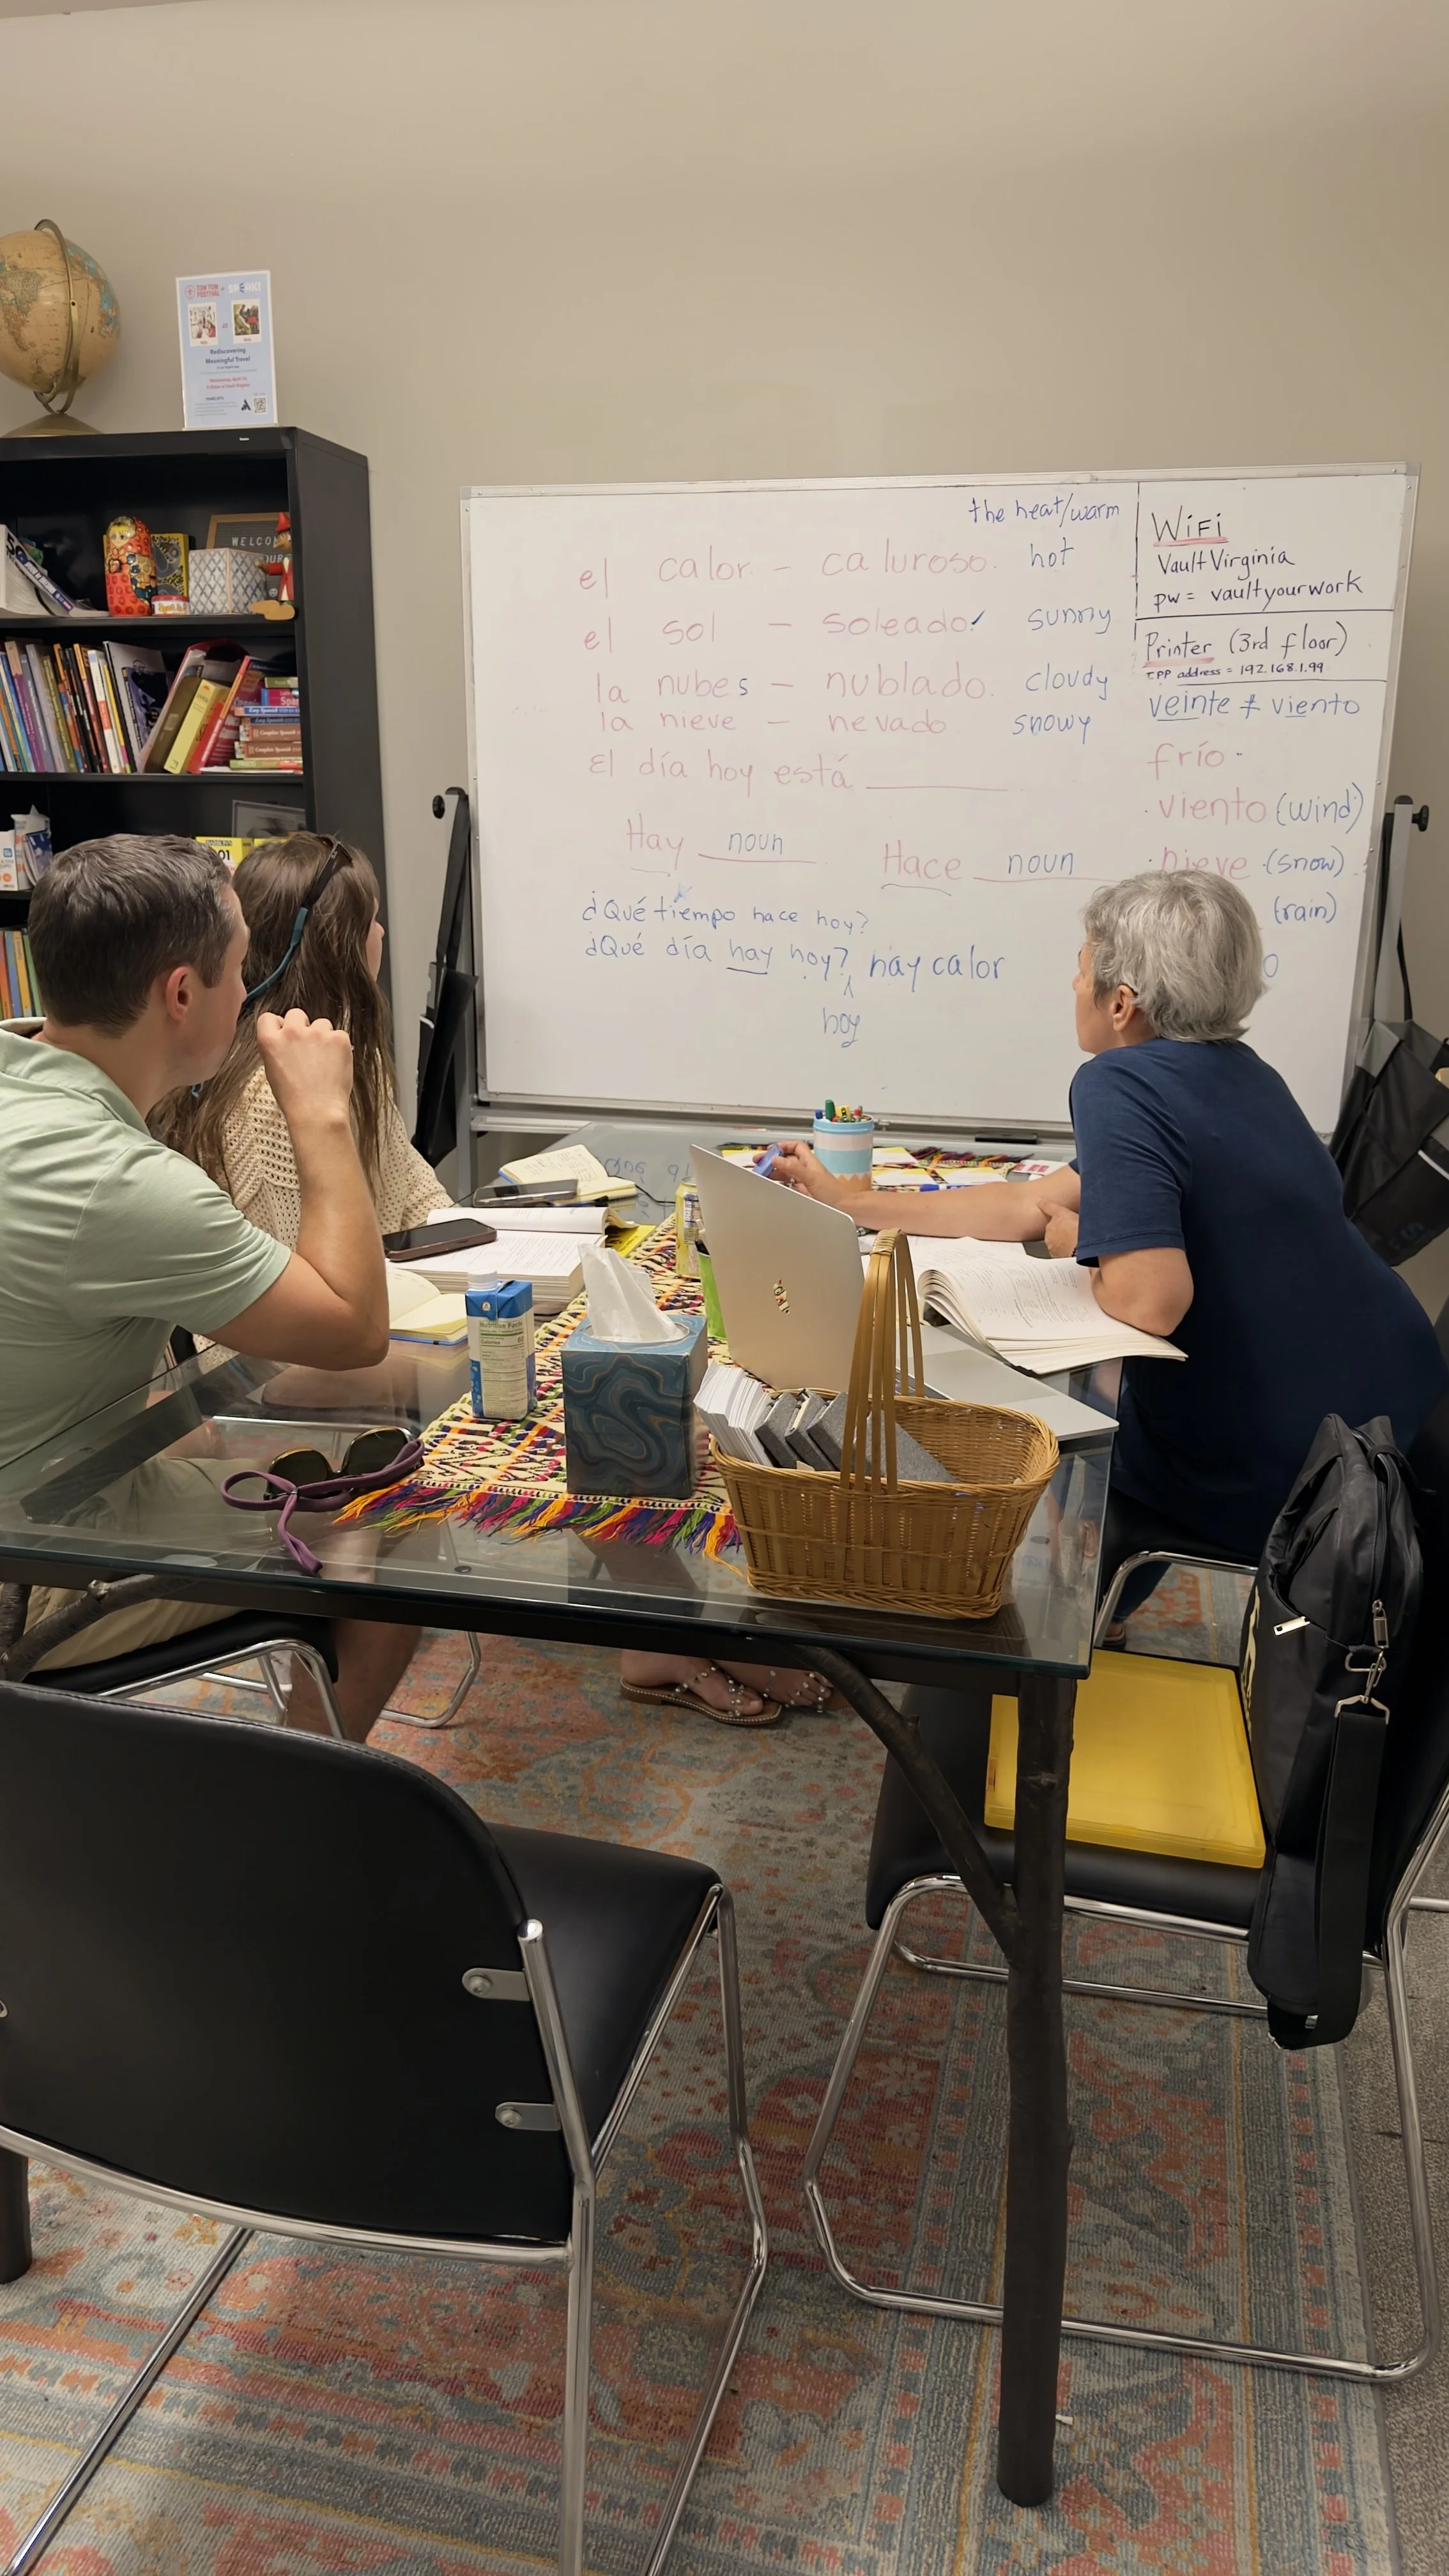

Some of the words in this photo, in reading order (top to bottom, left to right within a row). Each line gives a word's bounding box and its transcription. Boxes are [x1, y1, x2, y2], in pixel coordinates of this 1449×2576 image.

[968, 497, 1005, 523] the
[1015, 493, 1119, 528] heat/warm
[1151, 505, 1222, 542] WiFi
[1031, 537, 1075, 569] hot
[579, 557, 608, 599] el
[1153, 592, 1181, 613] pw
[1211, 569, 1365, 612] vaultyourwork
[584, 615, 612, 653] el
[662, 611, 715, 645] sol
[1027, 607, 1114, 634] sunny
[1145, 631, 1213, 661] Printer
[1229, 625, 1269, 655] (3rd
[1280, 620, 1348, 660] floor)
[597, 672, 630, 703] la
[657, 670, 748, 698] nubes
[1025, 662, 1110, 701] cloudy
[1177, 666, 1222, 679] address
[1240, 661, 1324, 676] 192.168.1.99
[601, 711, 634, 732] la
[659, 710, 737, 730] nieve
[1149, 689, 1231, 718] veinte
[1271, 692, 1361, 716] viento
[1013, 713, 1092, 744] snowy
[638, 748, 688, 779] día
[707, 749, 755, 798] hoy
[774, 754, 854, 789] está
[1147, 740, 1225, 781] frío
[1159, 786, 1267, 826] viento
[1276, 781, 1364, 834] (wind)
[625, 813, 684, 870] Hay
[728, 832, 784, 855] noun
[881, 839, 962, 882] Hace
[1008, 852, 1075, 875] noun
[1266, 845, 1345, 878] (snow)
[654, 894, 736, 930] tiempo
[753, 906, 798, 924] hace
[817, 910, 869, 936] hoy?
[1274, 891, 1337, 925] (rain)
[666, 935, 712, 962] día
[729, 938, 774, 969] hay
[790, 943, 848, 981] hoy?
[932, 944, 1005, 979] calor
[823, 1007, 861, 1048] hoy
